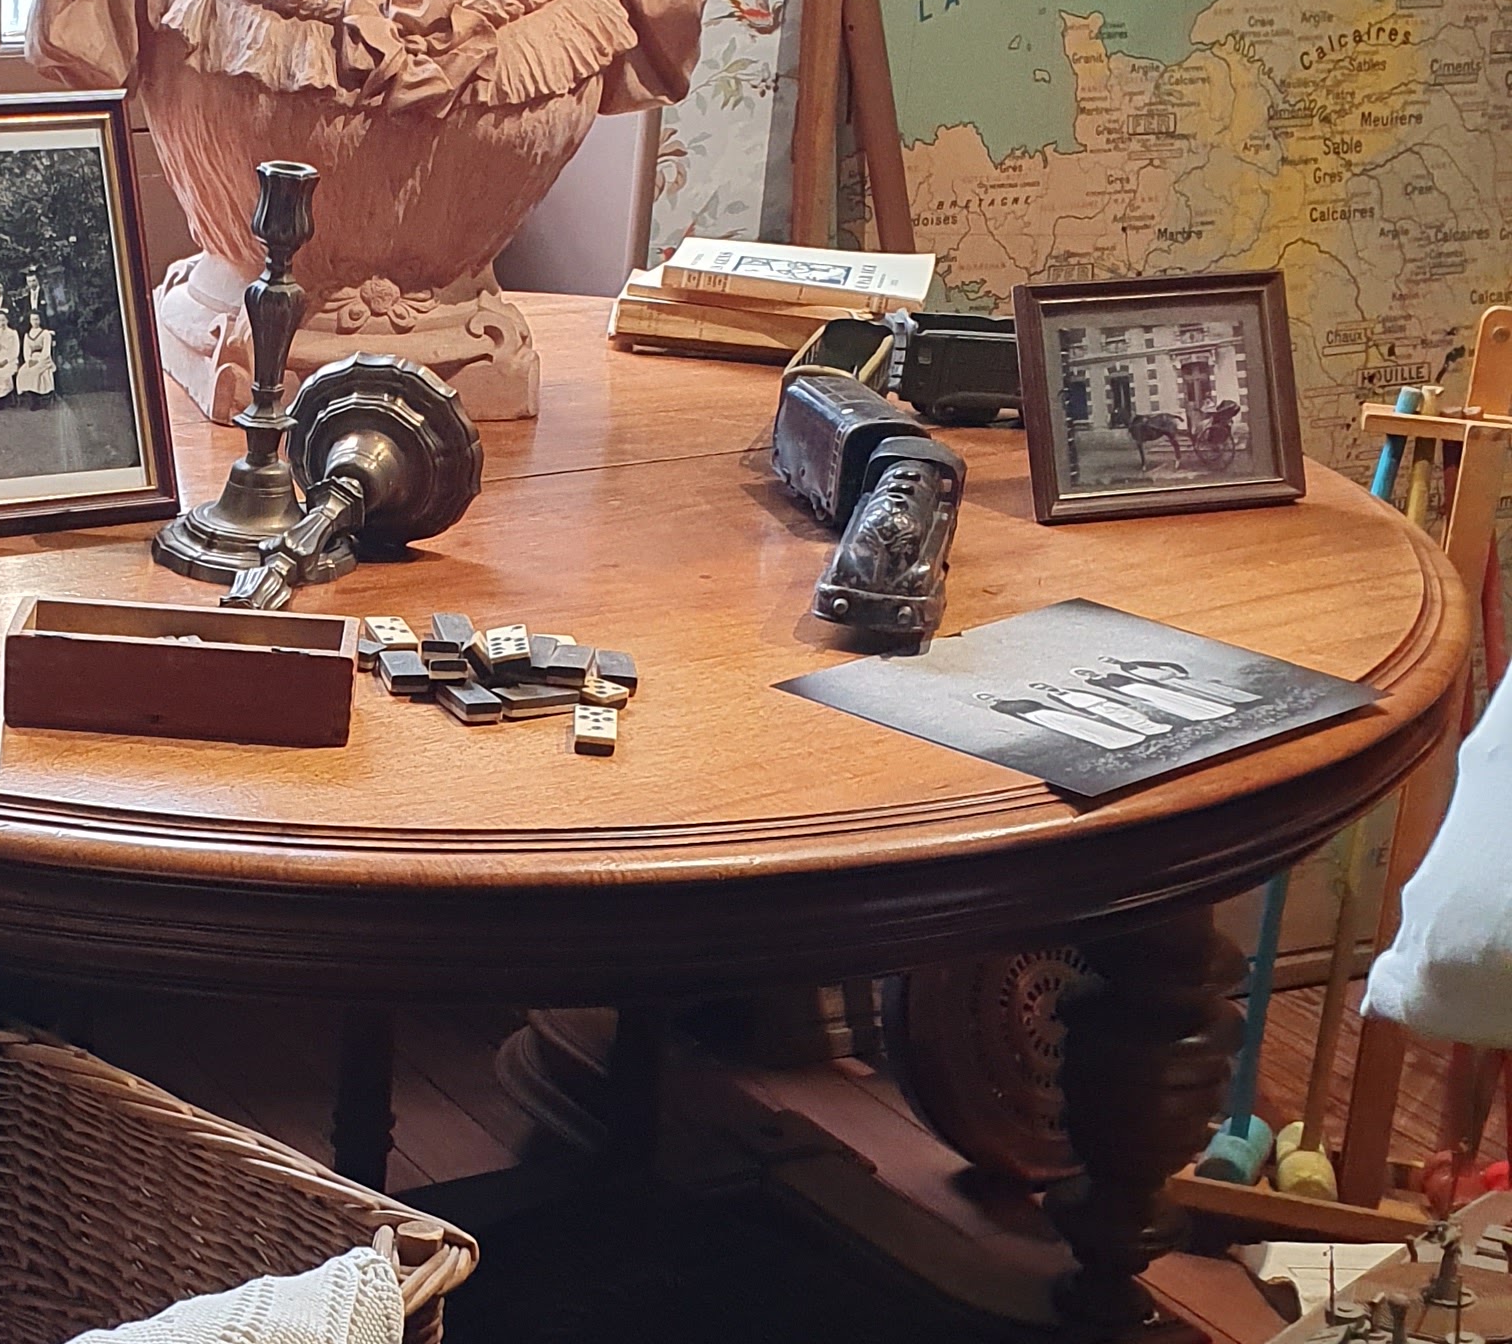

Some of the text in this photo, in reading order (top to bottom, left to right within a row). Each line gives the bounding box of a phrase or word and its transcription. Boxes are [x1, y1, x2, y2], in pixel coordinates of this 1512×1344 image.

[1299, 22, 1412, 70] Calcaires
[1348, 56, 1387, 72] Sables
[1430, 58, 1482, 75] Ciments
[1322, 137, 1363, 156] Sable
[937, 194, 1032, 210] BRETAGNE
[912, 214, 958, 227] doises
[1309, 206, 1376, 223] Calcaires
[1156, 227, 1203, 242] Marbre
[1326, 329, 1363, 346] Chaux
